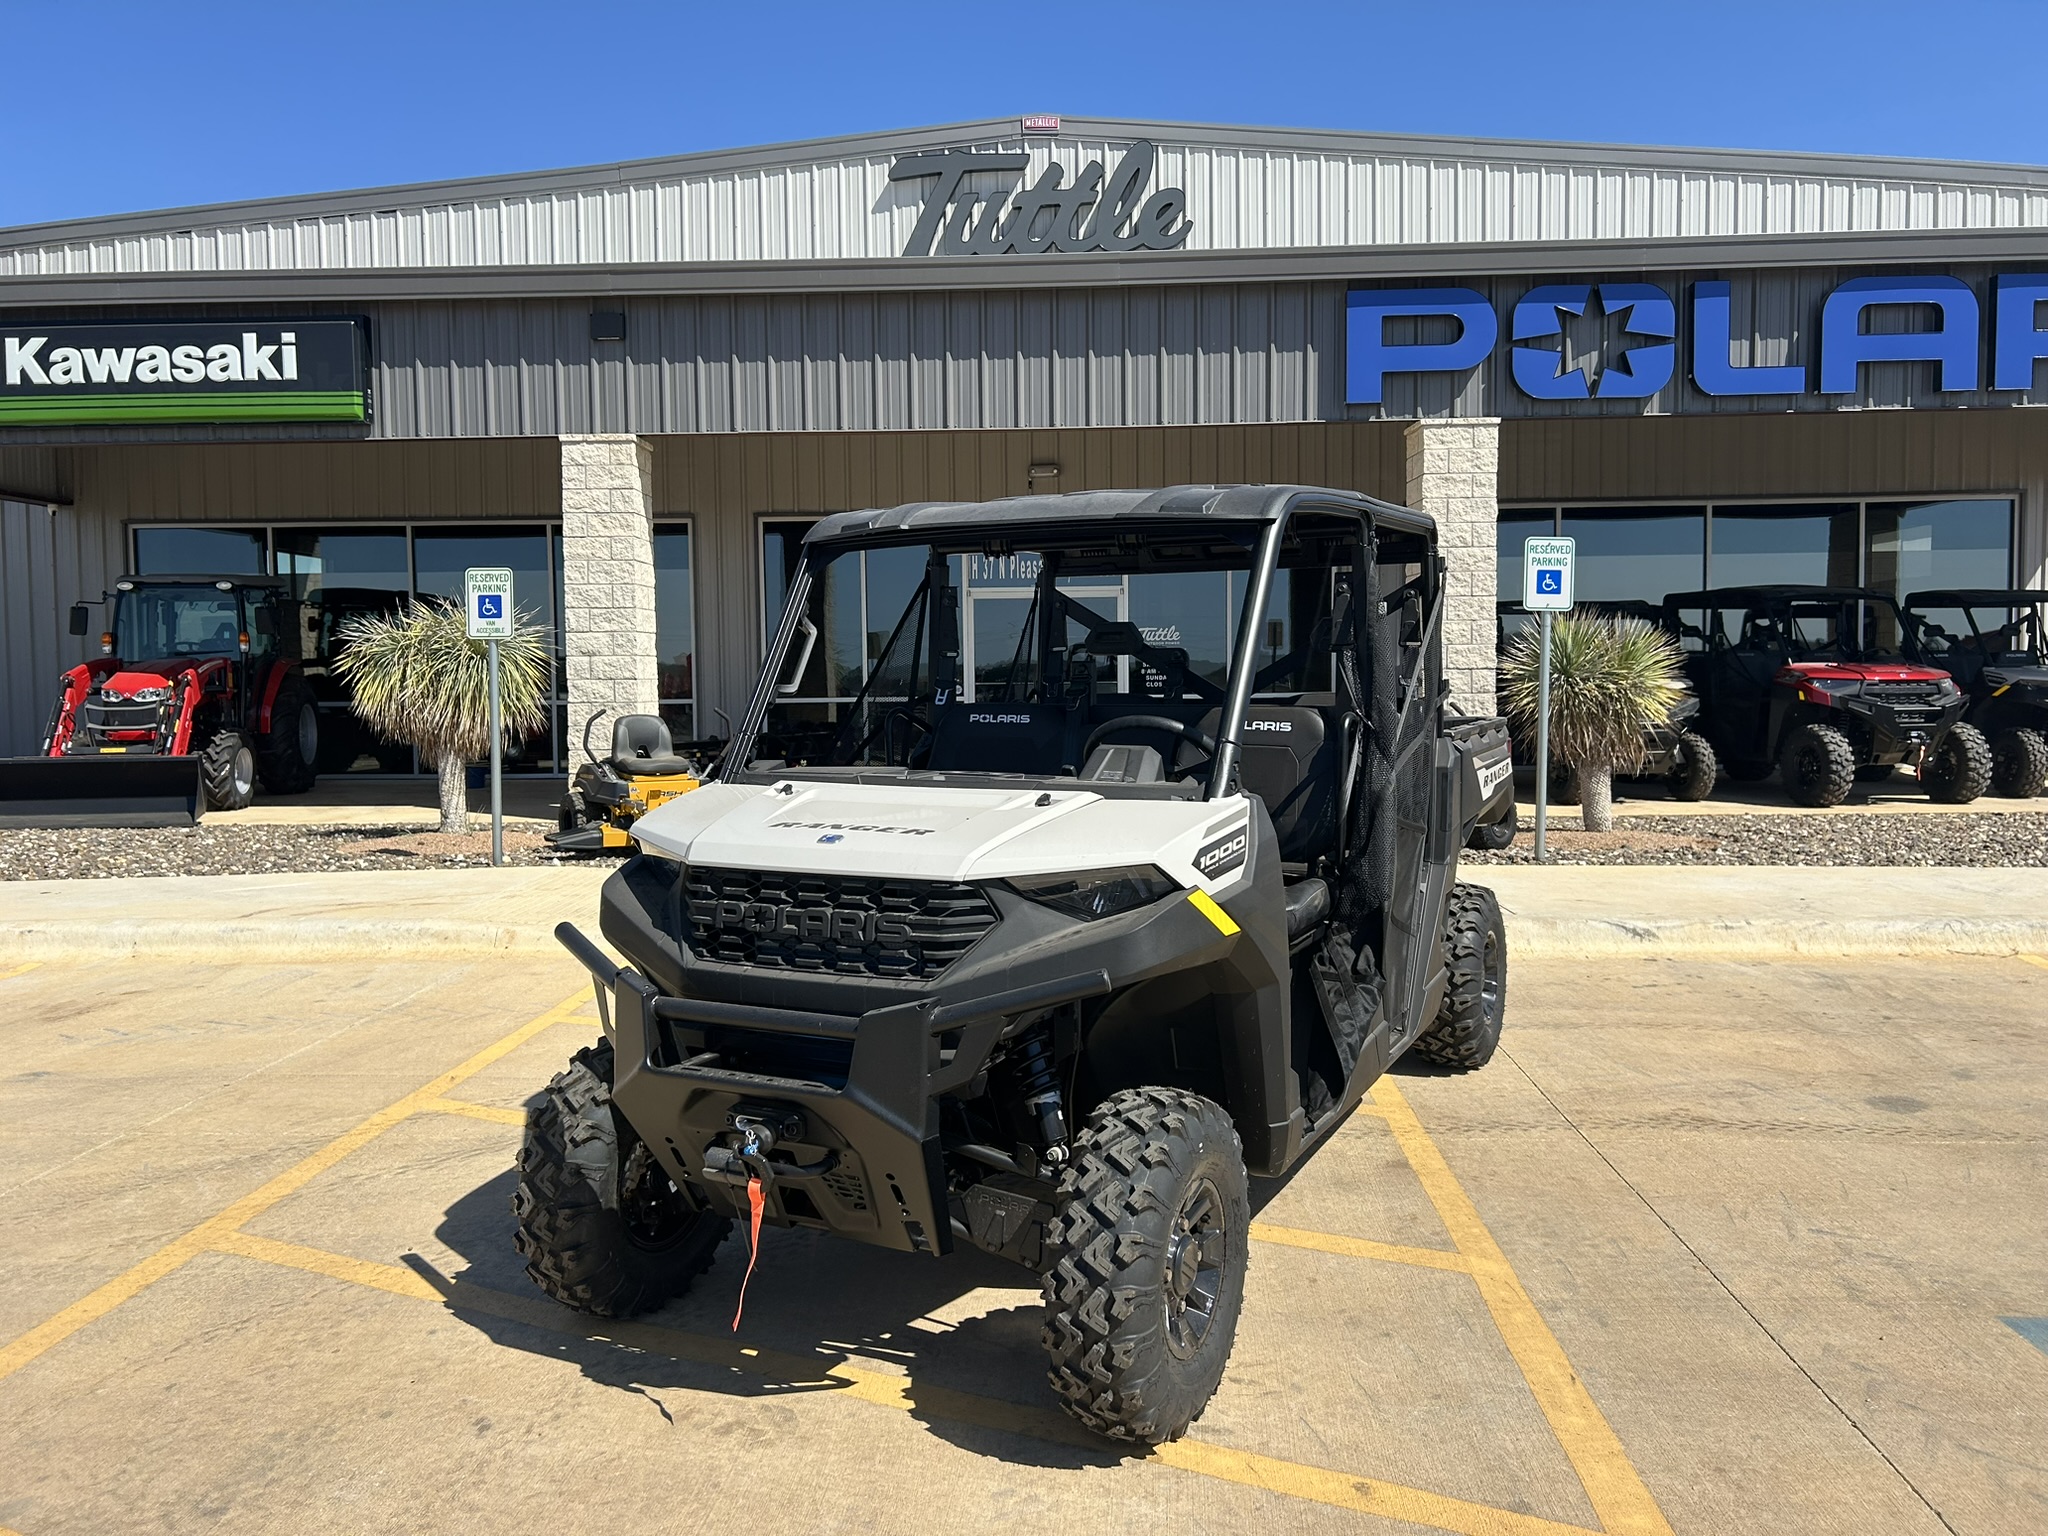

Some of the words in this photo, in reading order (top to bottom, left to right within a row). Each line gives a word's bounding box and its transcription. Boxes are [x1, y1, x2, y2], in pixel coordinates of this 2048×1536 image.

[1026, 118, 1056, 127] METALLIC
[888, 139, 1193, 257] Tuttle
[4, 331, 299, 386] Kawasaki
[1529, 545, 1571, 554] RESERVED
[983, 556, 994, 580] 37
[999, 555, 1006, 580] N
[1532, 557, 1567, 566] PARKING
[469, 573, 509, 583] RESERVED
[471, 583, 507, 592] PARKING
[1138, 625, 1181, 641] Tuttle
[969, 714, 1031, 723] POLARIS
[1243, 720, 1292, 732] LARIS
[1483, 762, 1509, 788] RANGER
[768, 821, 936, 836] RANGER
[1199, 834, 1246, 870] 1000
[715, 900, 913, 943] POLARIS
